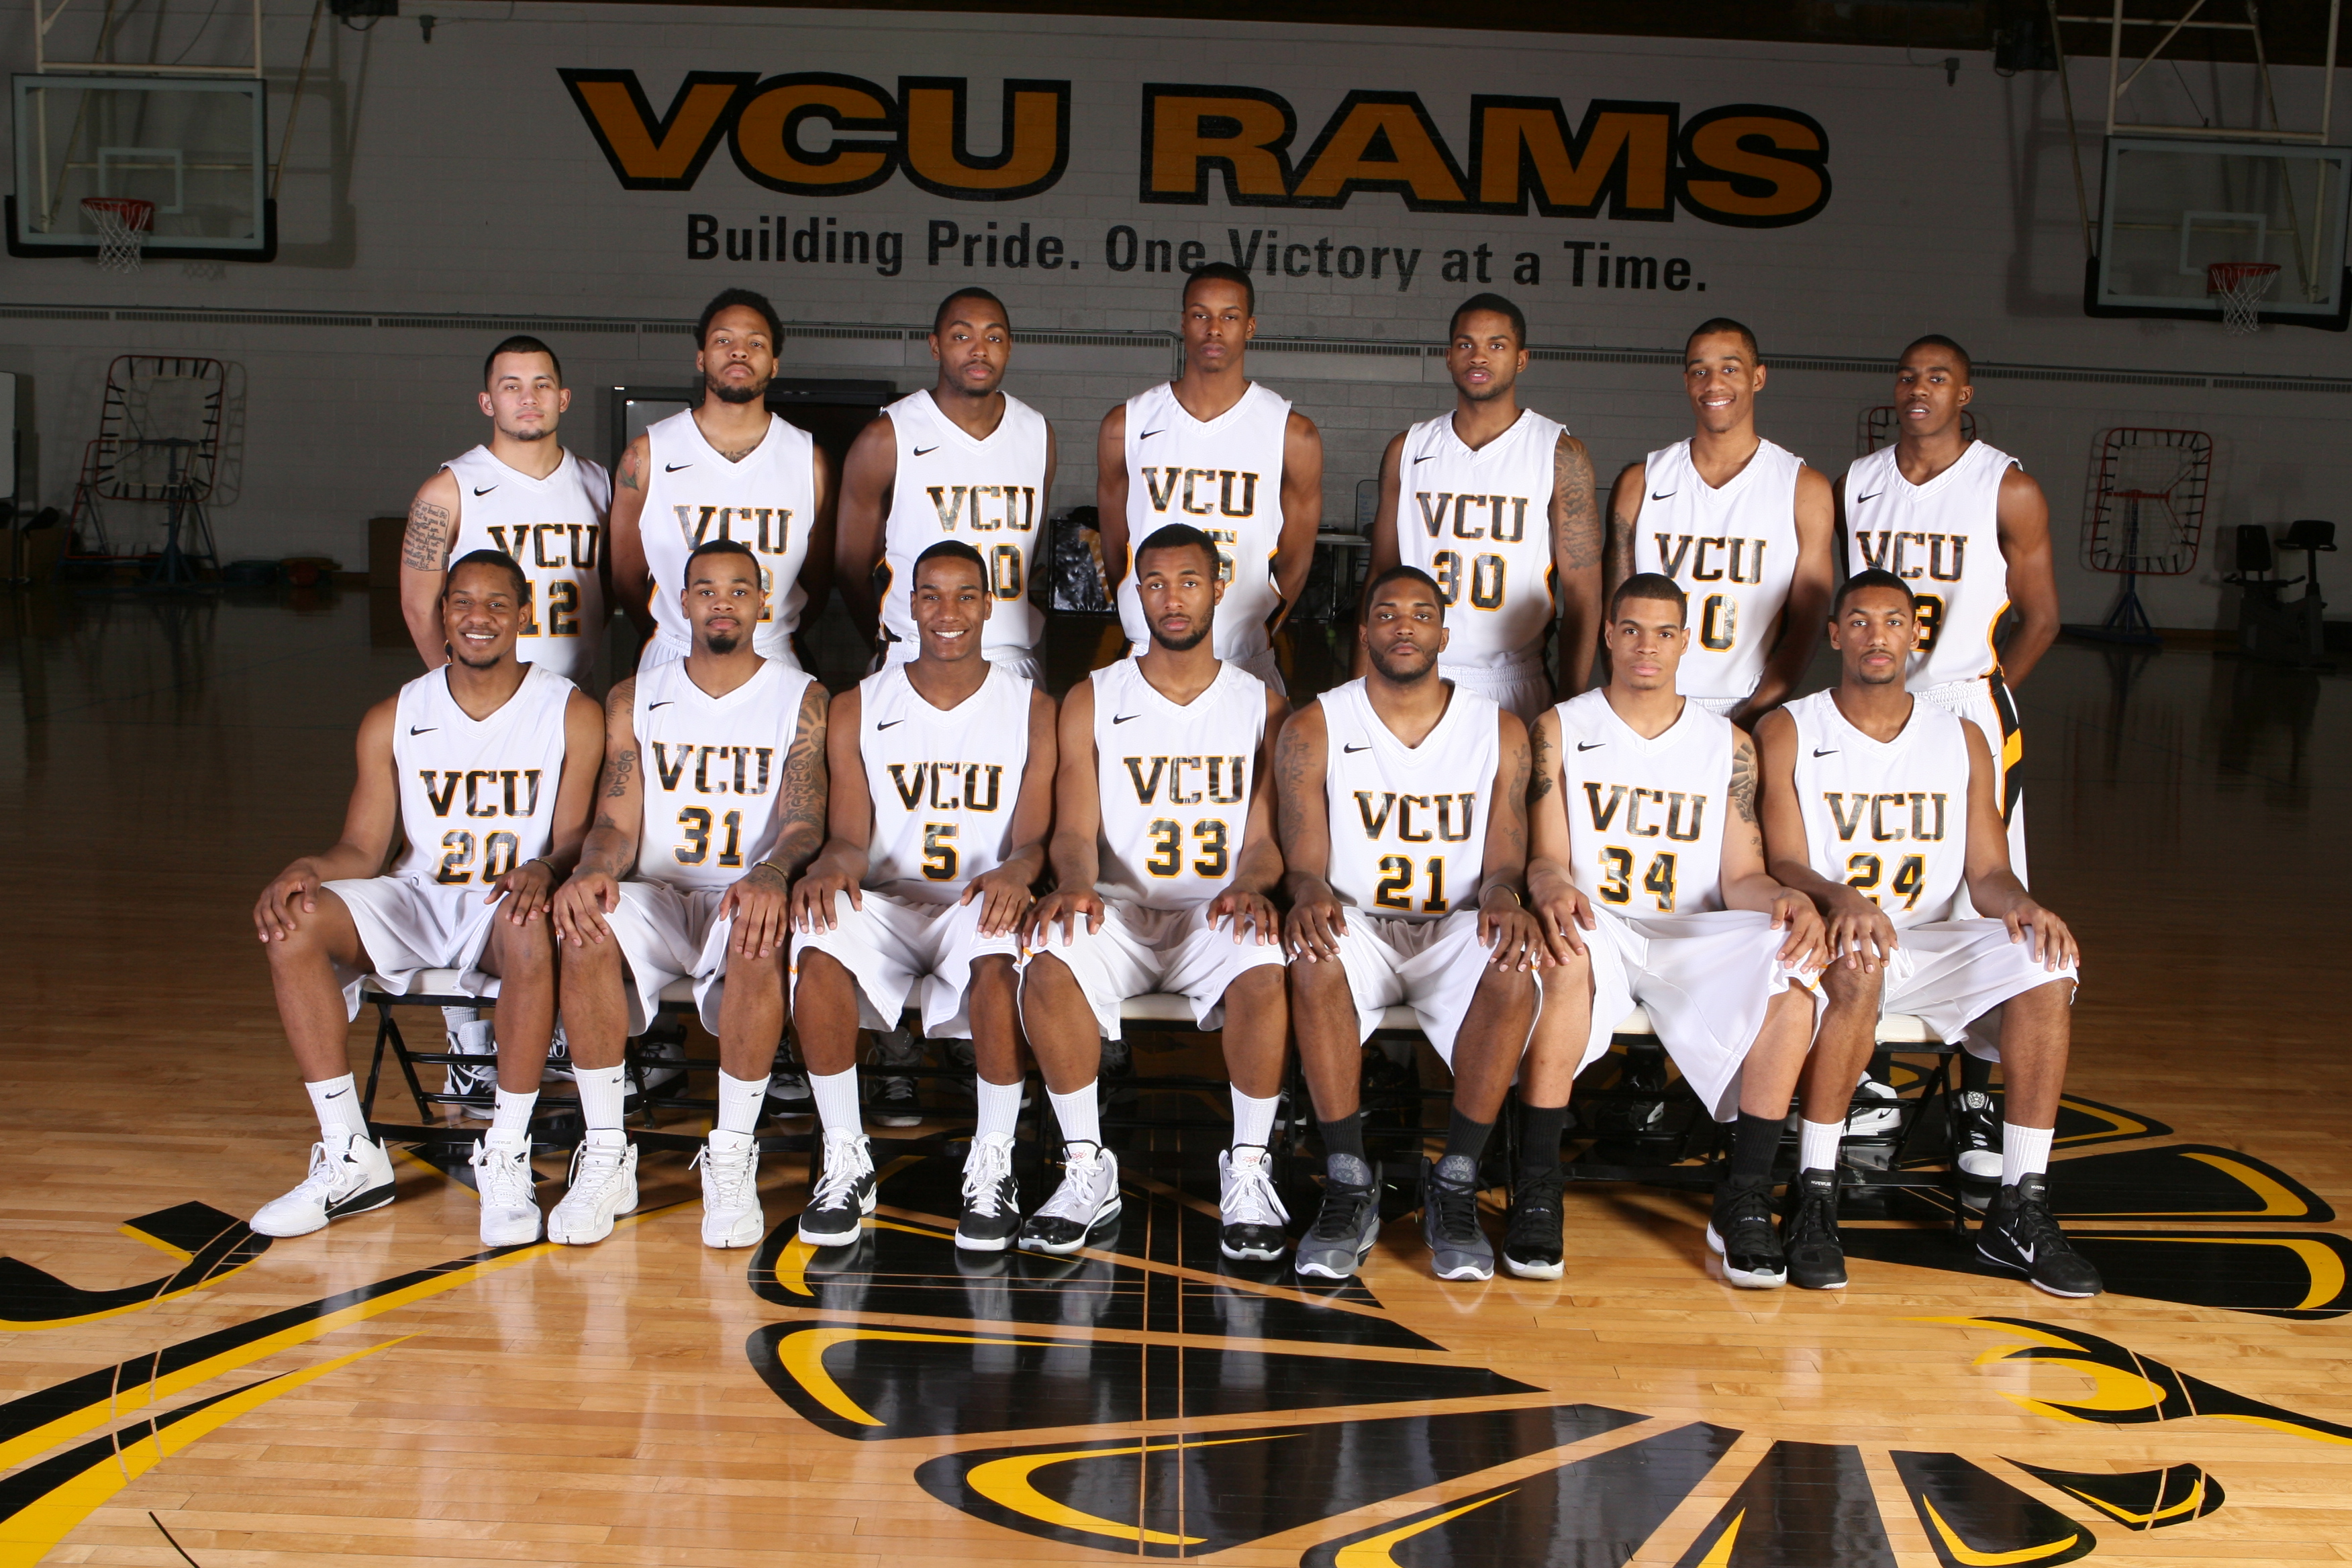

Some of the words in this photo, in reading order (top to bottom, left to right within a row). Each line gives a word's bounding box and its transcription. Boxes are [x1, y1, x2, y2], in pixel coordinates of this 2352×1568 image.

[556, 68, 1071, 201] VCU
[1139, 83, 1832, 229] RAMS
[687, 214, 903, 277] Building
[929, 220, 1079, 270] Pride.
[1106, 225, 1207, 274] One
[1228, 228, 1421, 293] Victory
[1441, 242, 1491, 284] at
[1514, 252, 1540, 286] a
[1564, 240, 1706, 293] Time.
[926, 485, 1036, 534] VCU
[1141, 467, 1260, 518] VCU
[1416, 491, 1529, 544] VCU
[487, 523, 599, 570] VCU
[673, 504, 794, 556] VCU
[1855, 530, 1968, 583] VCU
[1431, 549, 1508, 612] 30
[1653, 532, 1768, 585] VCU
[517, 579, 581, 638] 12
[419, 768, 544, 819] VCU
[651, 740, 775, 796] VCU
[886, 761, 1004, 814] VCU
[1122, 755, 1246, 805] VCU
[673, 805, 744, 869] 31
[1353, 790, 1476, 844] VCU
[1581, 781, 1708, 844] VCU
[1822, 791, 1949, 843] VCU
[435, 828, 521, 885] 20
[920, 821, 960, 882] 5
[1144, 817, 1230, 879] 33
[1373, 853, 1449, 914] 21
[1598, 844, 1678, 913] 34
[1846, 852, 1926, 912] 24
